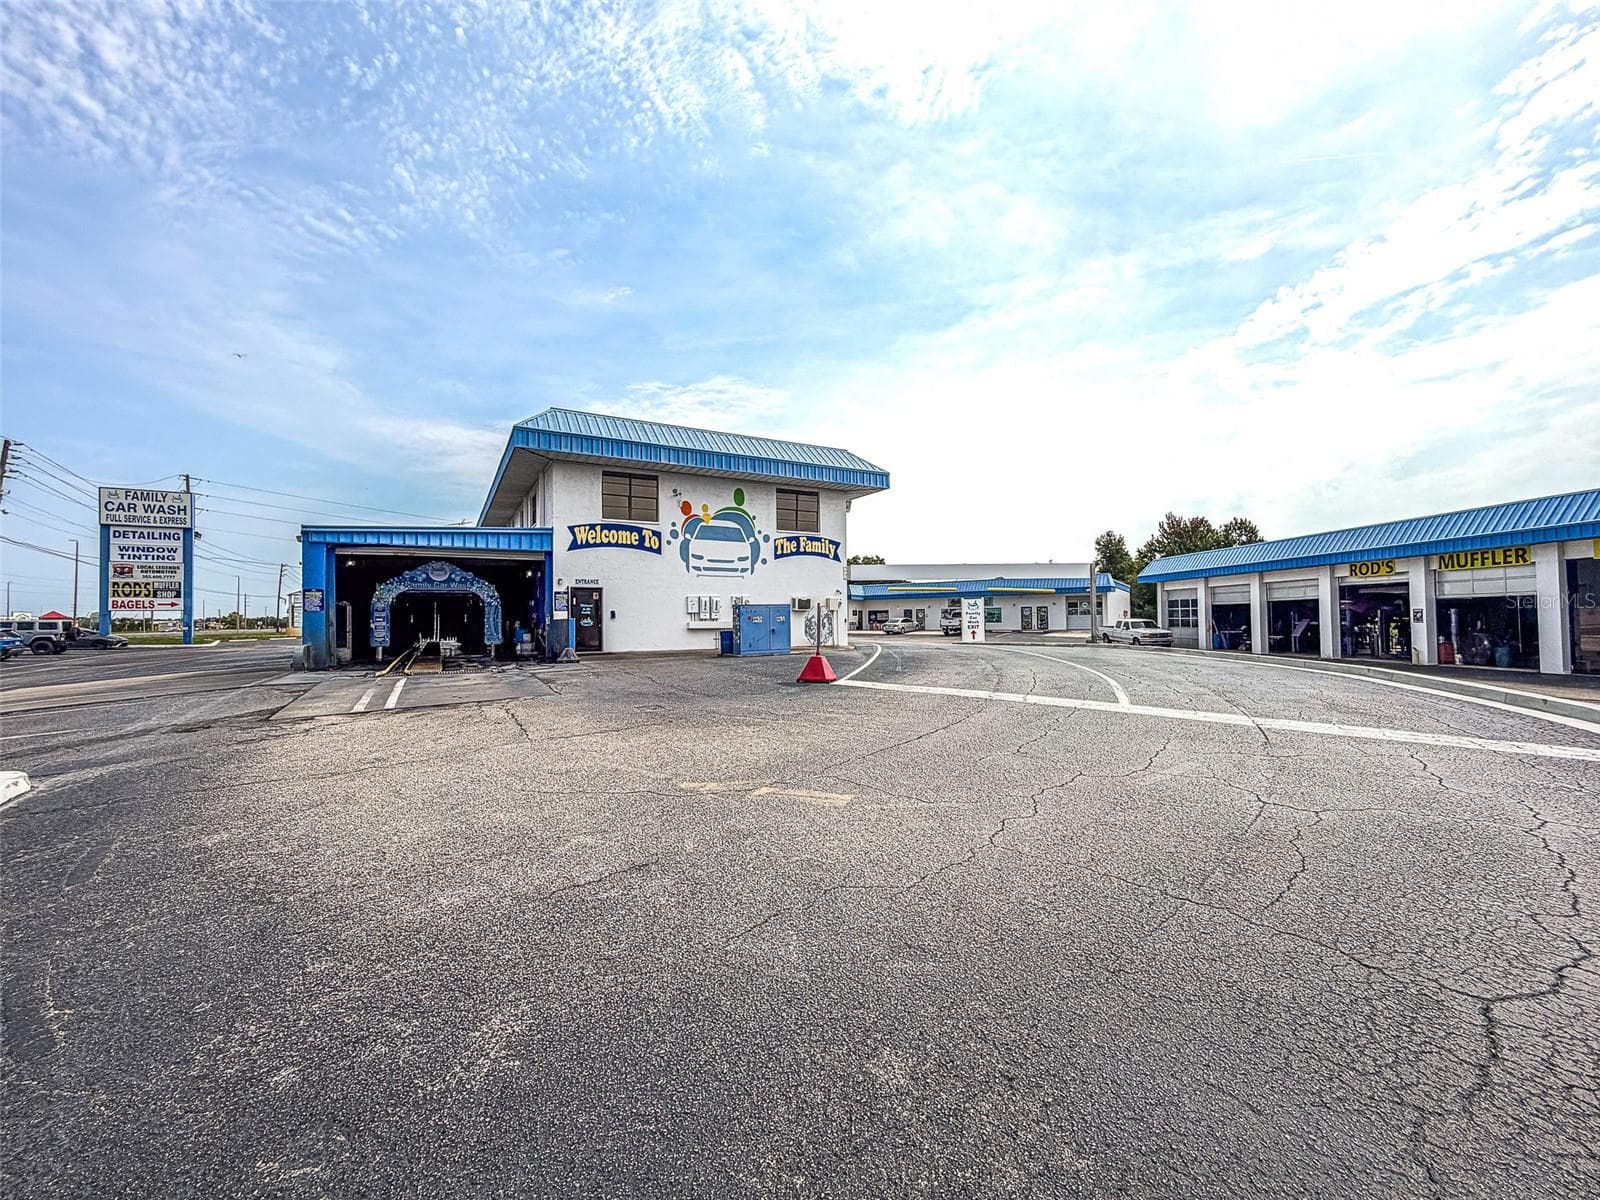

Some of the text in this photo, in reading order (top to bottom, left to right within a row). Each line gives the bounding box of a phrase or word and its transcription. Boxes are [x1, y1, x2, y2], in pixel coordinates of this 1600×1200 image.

[125, 490, 168, 503] FAMILY
[104, 501, 187, 516] CAR WASH
[105, 514, 187, 525] FULL SERVICE & EXPRESS
[112, 530, 181, 541] DETAILING
[575, 525, 659, 549] Welcome To
[118, 545, 178, 554] WINDOW
[775, 536, 836, 559] The Family
[118, 553, 176, 561] TINTING
[1438, 547, 1529, 570] MUFFLER
[1350, 560, 1395, 577] ROD'S
[111, 581, 151, 598] ROD'S
[111, 599, 155, 609] BAGELS
